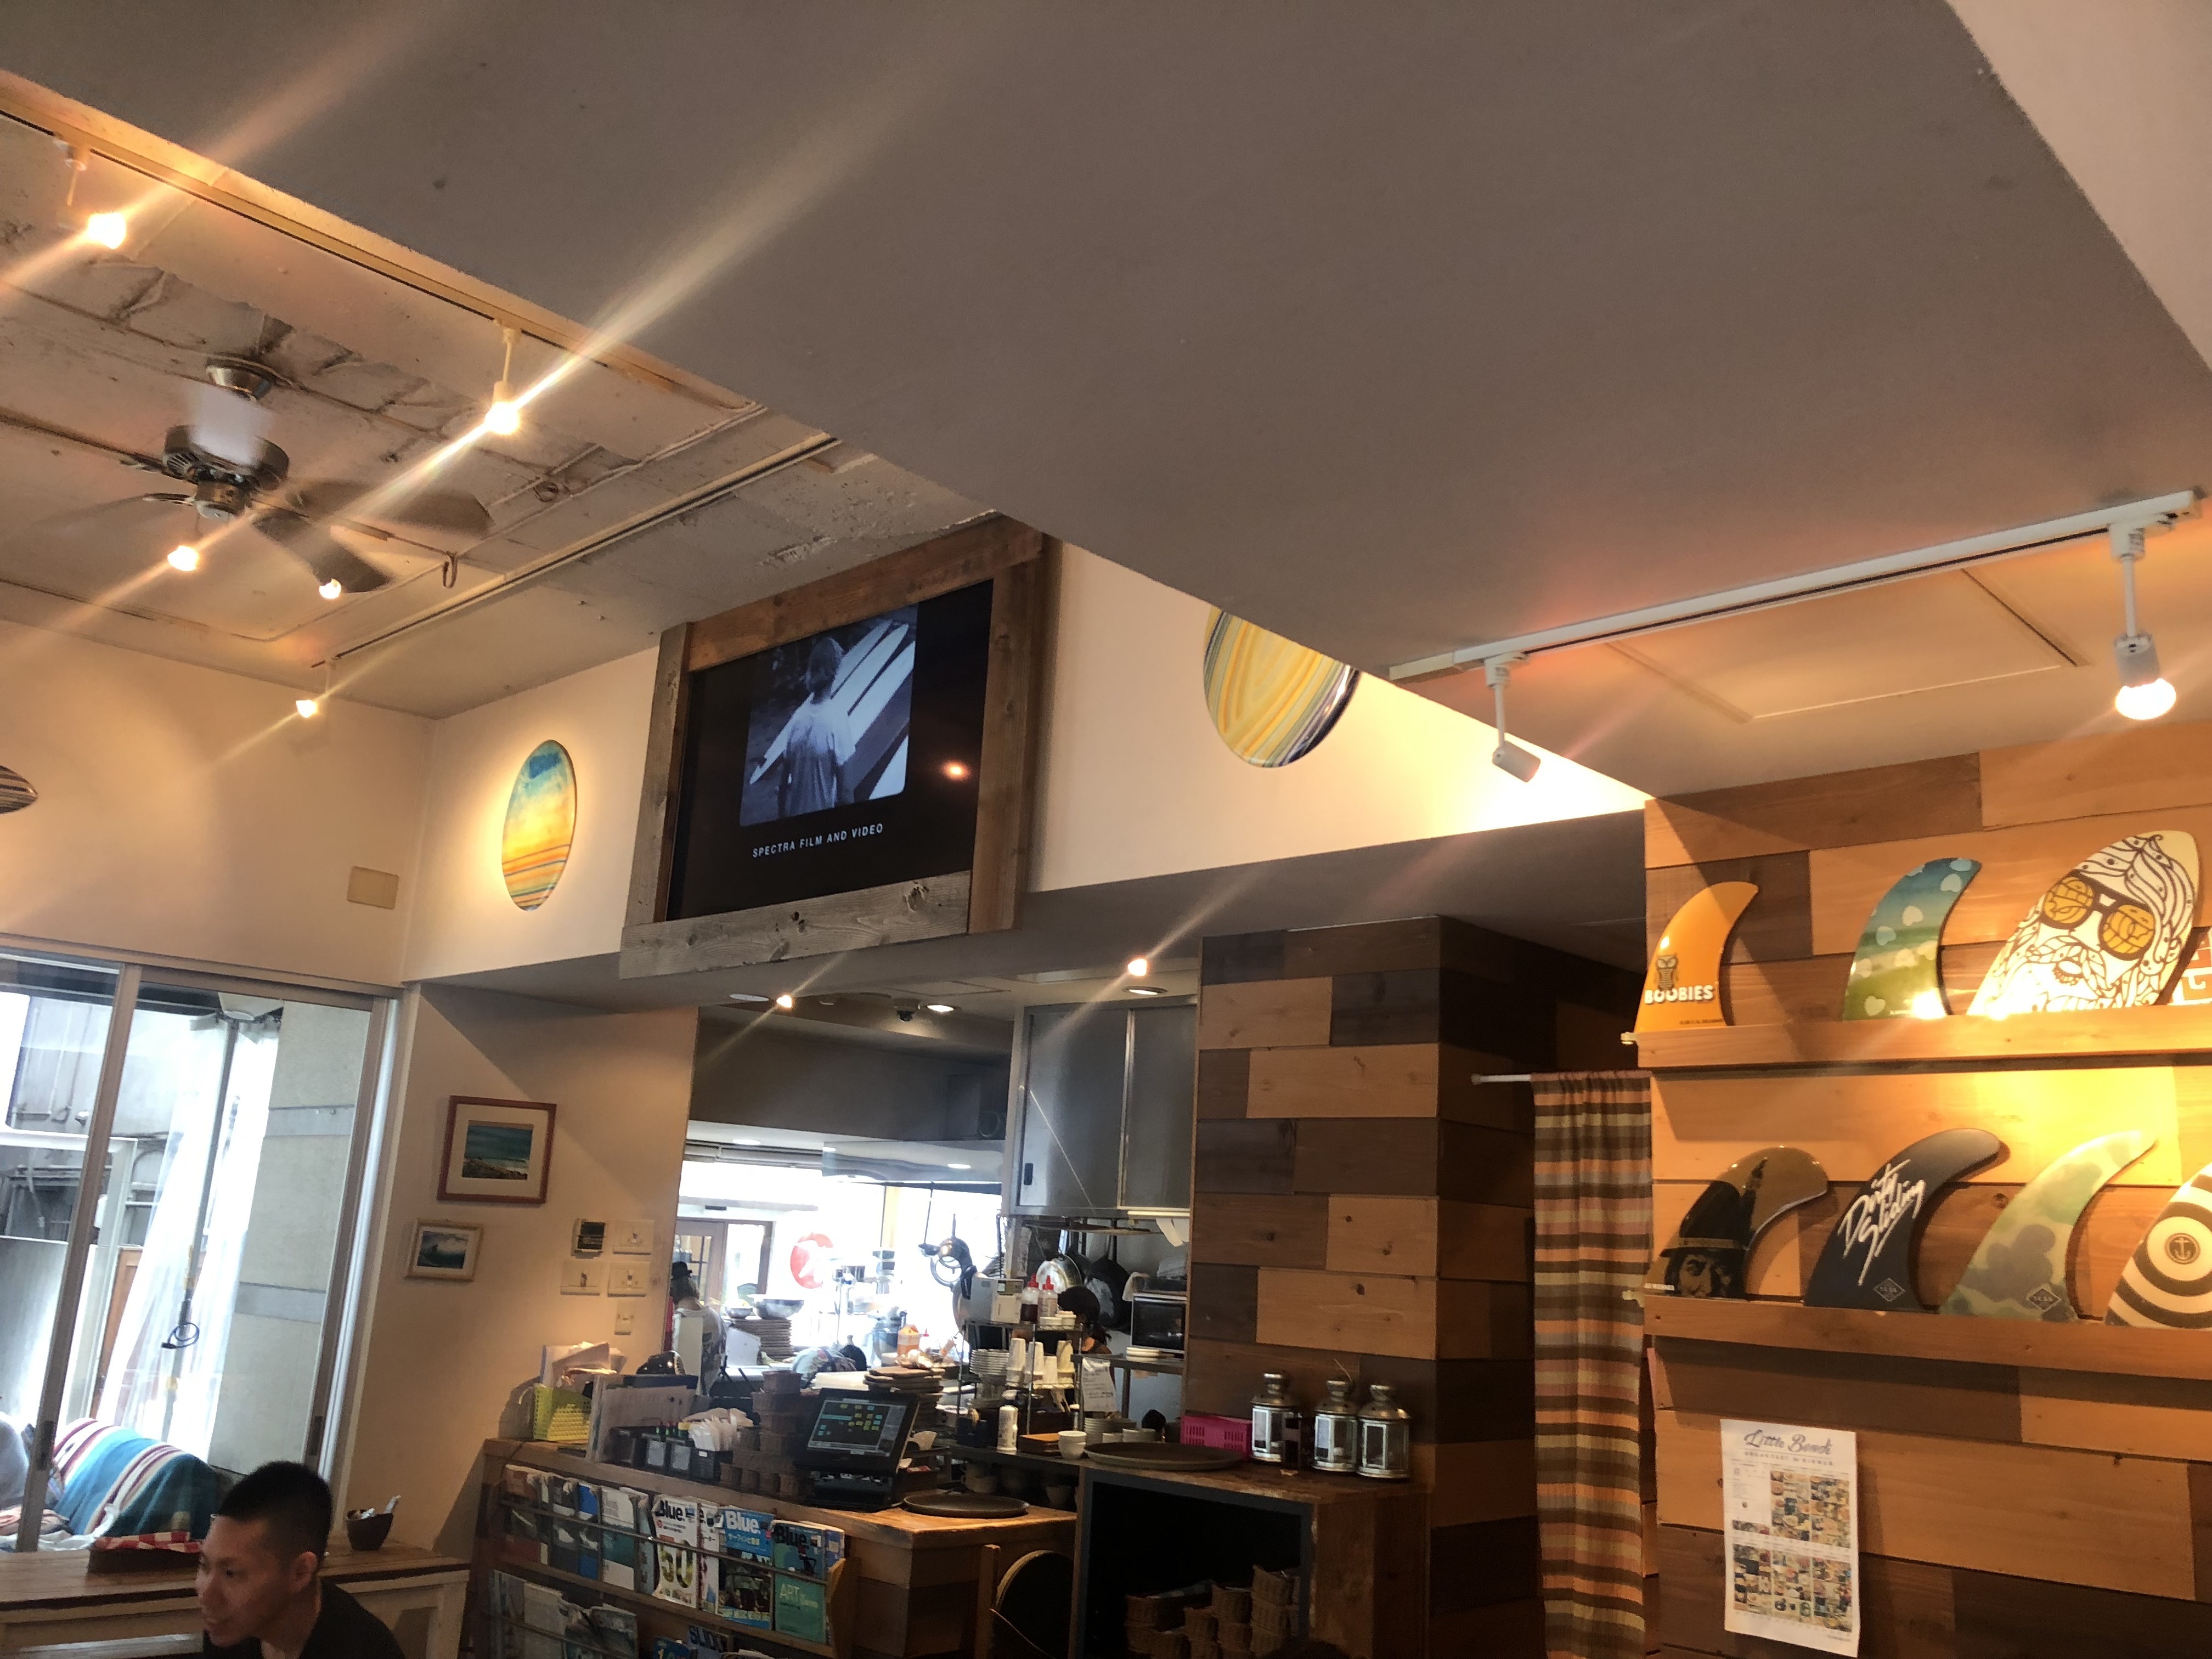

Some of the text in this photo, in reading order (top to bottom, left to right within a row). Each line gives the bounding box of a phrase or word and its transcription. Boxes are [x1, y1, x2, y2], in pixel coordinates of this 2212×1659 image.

[752, 822, 883, 859] SPECTRA FILM AND VIDEO
[1644, 984, 1714, 1005] BOOBIES
[725, 1510, 761, 1534] Blue.
